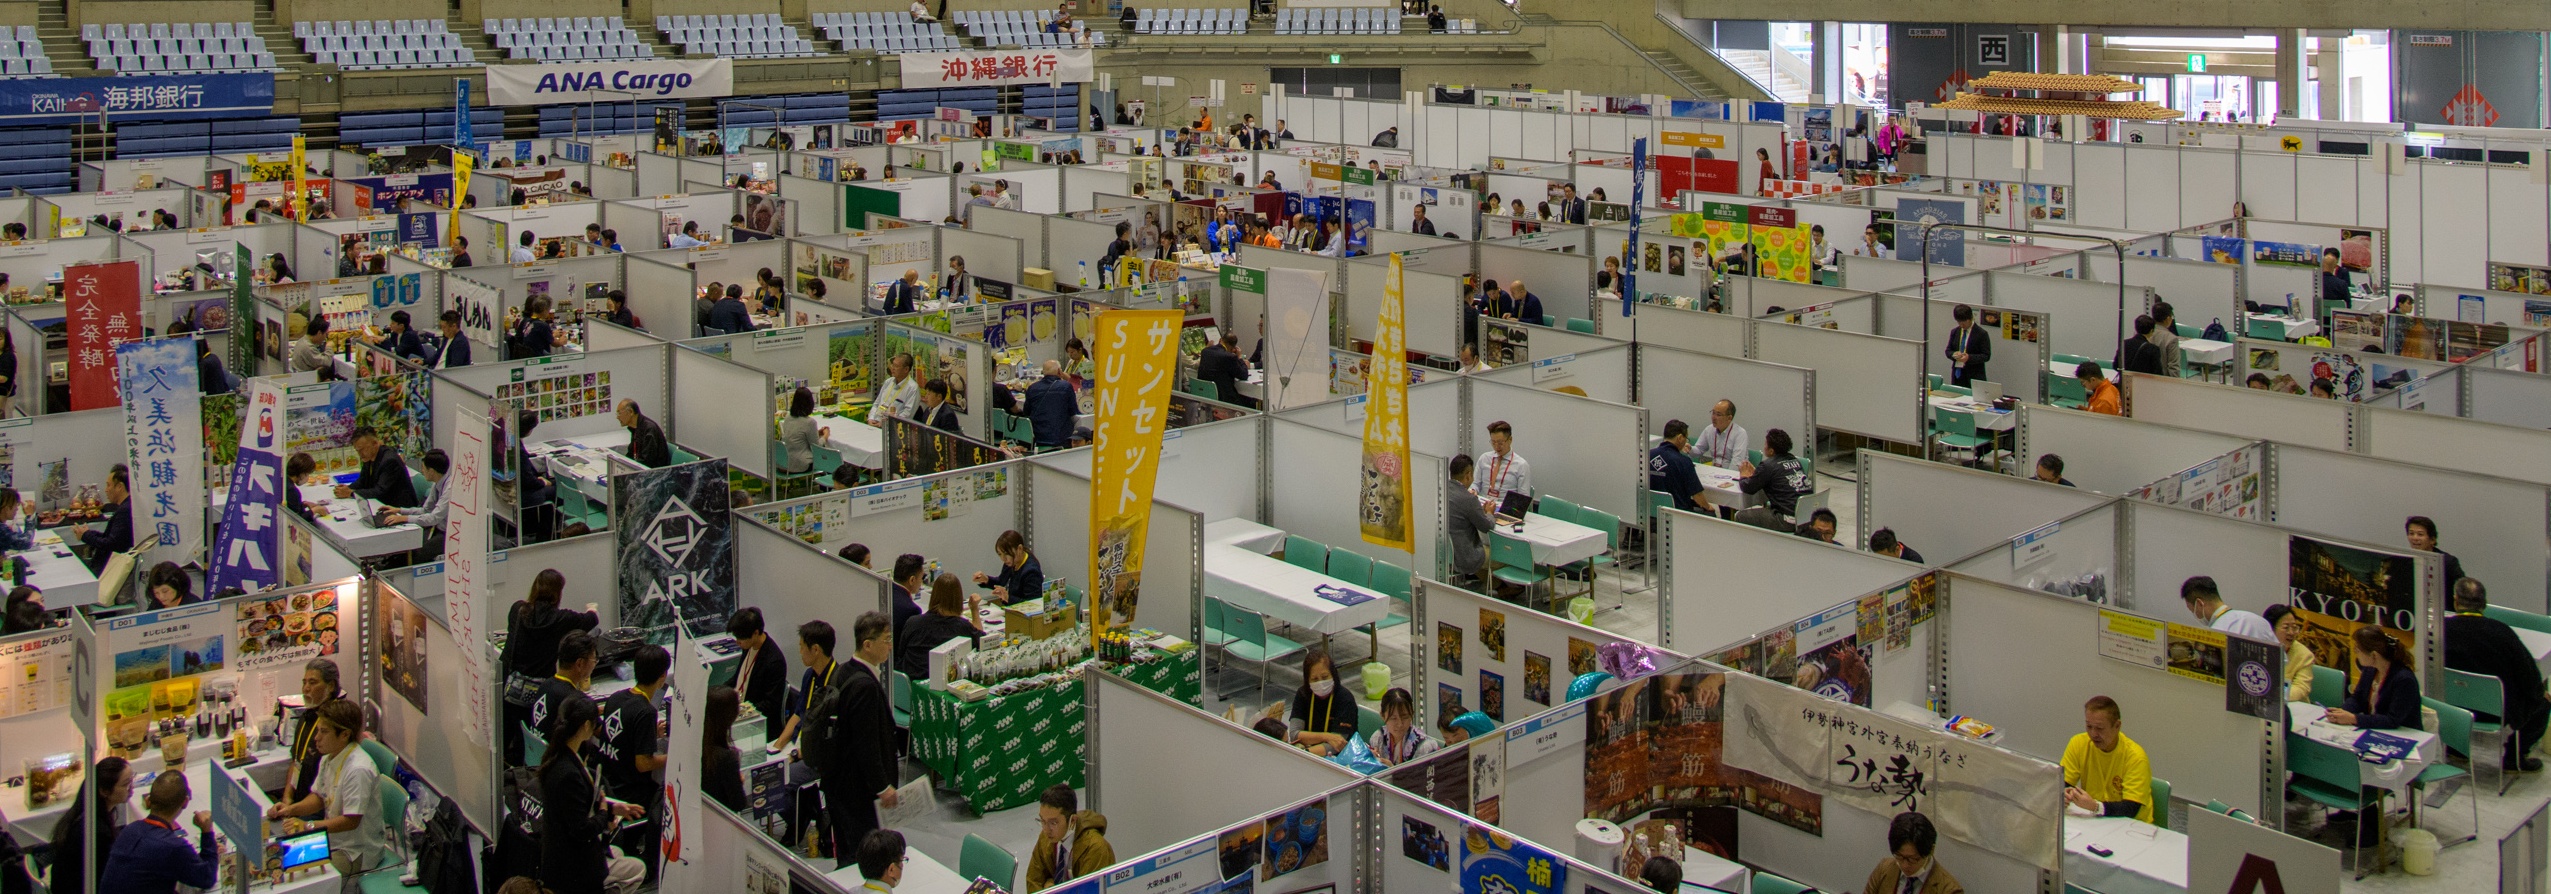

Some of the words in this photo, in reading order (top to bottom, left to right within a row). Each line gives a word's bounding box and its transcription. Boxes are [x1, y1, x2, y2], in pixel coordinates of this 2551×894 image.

[1980, 38, 2007, 63] 西
[941, 55, 1058, 81] 沖縄銀行
[535, 71, 605, 94] ANA
[612, 70, 693, 96] Cargo
[104, 85, 204, 111] 海邦銀行
[530, 181, 563, 193] CACAO
[1116, 319, 1173, 515] サンセット
[642, 568, 713, 605] ARK
[2290, 586, 2416, 632] KYOTO
[1800, 621, 1809, 629] B04
[76, 638, 91, 718] C
[1512, 727, 1523, 737] B03
[1801, 707, 1967, 769] 伊勢神宮外宮奉納うなぎ
[1837, 743, 1927, 812] うな勢
[1115, 869, 1130, 881] B02
[1526, 856, 1553, 888] 楠
